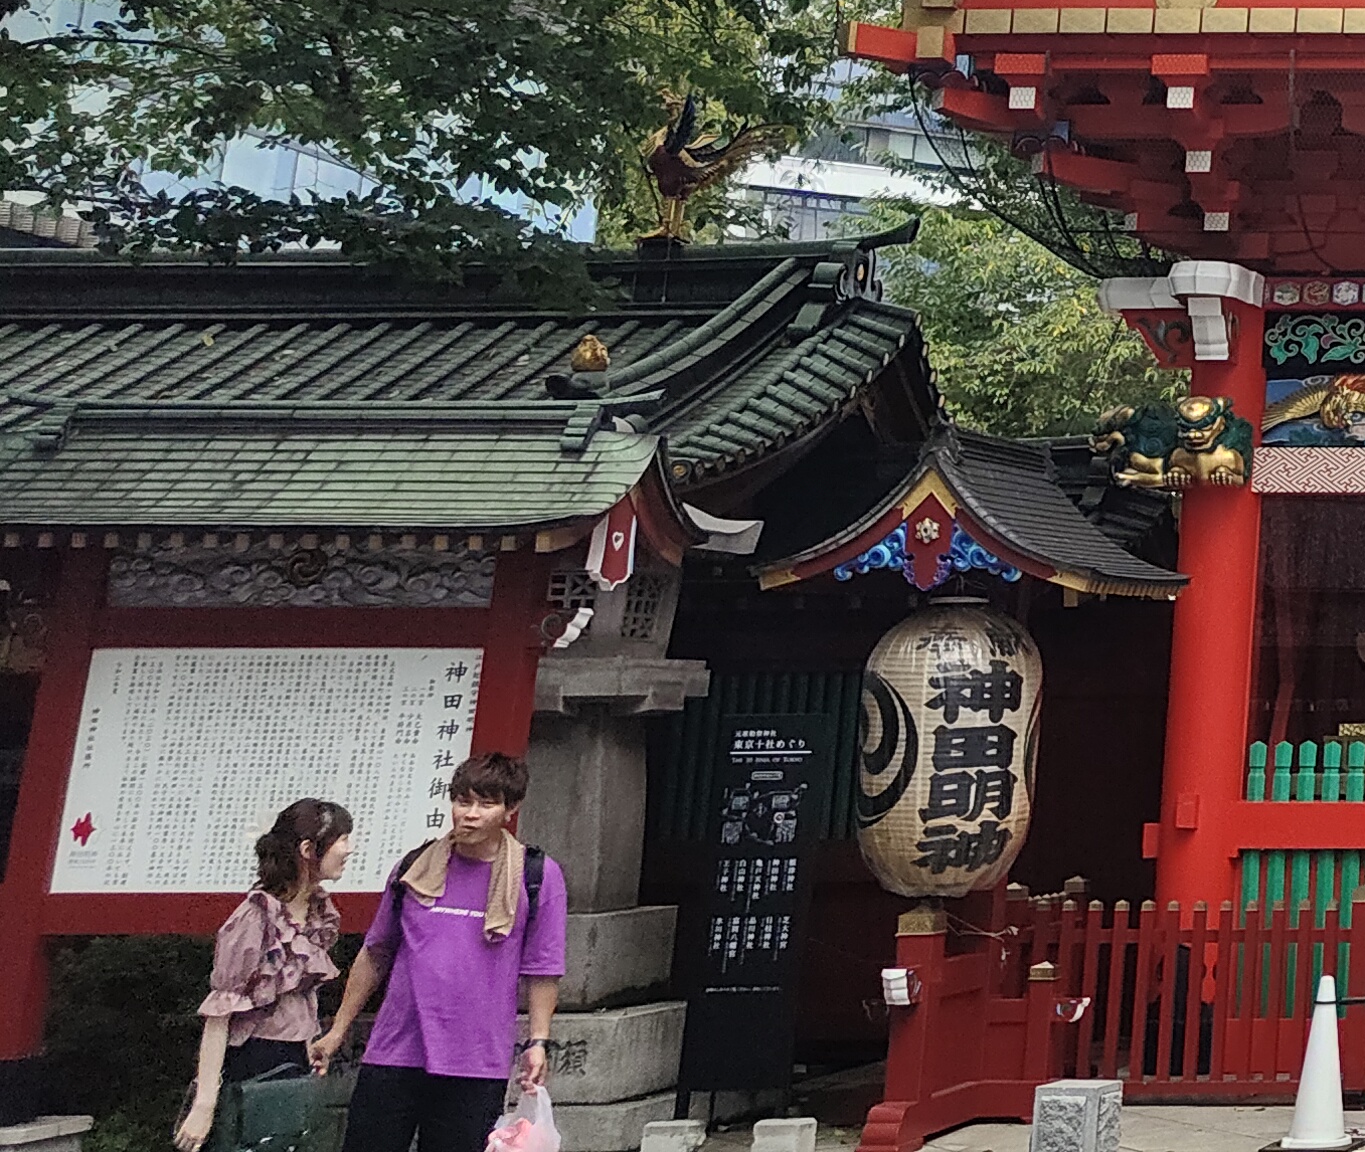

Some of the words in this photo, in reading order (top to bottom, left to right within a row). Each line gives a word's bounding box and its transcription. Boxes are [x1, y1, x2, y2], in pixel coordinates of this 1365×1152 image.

[424, 661, 468, 846] 神田神社御由
[733, 739, 806, 749] 東京十社めぐり
[910, 660, 1023, 873] 神田明神
